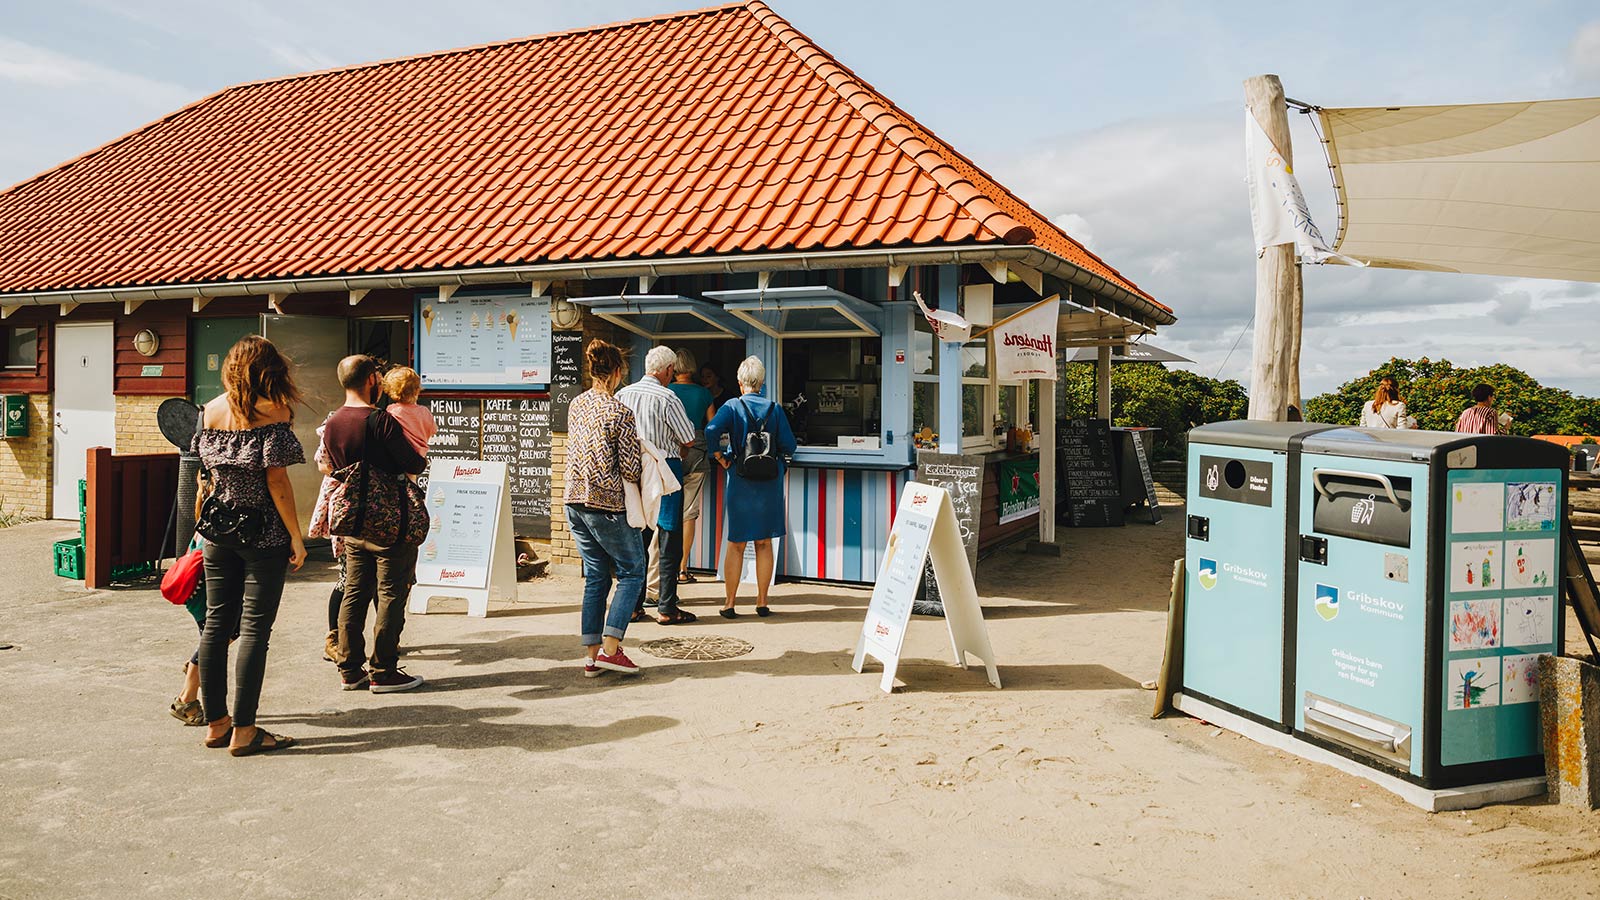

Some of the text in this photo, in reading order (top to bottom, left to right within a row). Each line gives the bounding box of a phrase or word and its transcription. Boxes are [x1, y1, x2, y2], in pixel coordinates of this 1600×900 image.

[430, 400, 462, 414] MENU
[486, 400, 512, 411] KAFFE
[519, 400, 532, 411] ØL
[447, 415, 469, 427] CHIPS
[483, 454, 511, 464] ESPRESSO
[453, 464, 482, 479] Hansens
[956, 479, 979, 494] tea
[1223, 562, 1268, 580] Gribskov
[1346, 590, 1404, 611] Gribskov
[1360, 603, 1405, 621] Kommune
[1331, 648, 1383, 670] Gribskovs børn
[1334, 659, 1379, 679] tegner for en
[1337, 670, 1376, 688] ren fremtid
